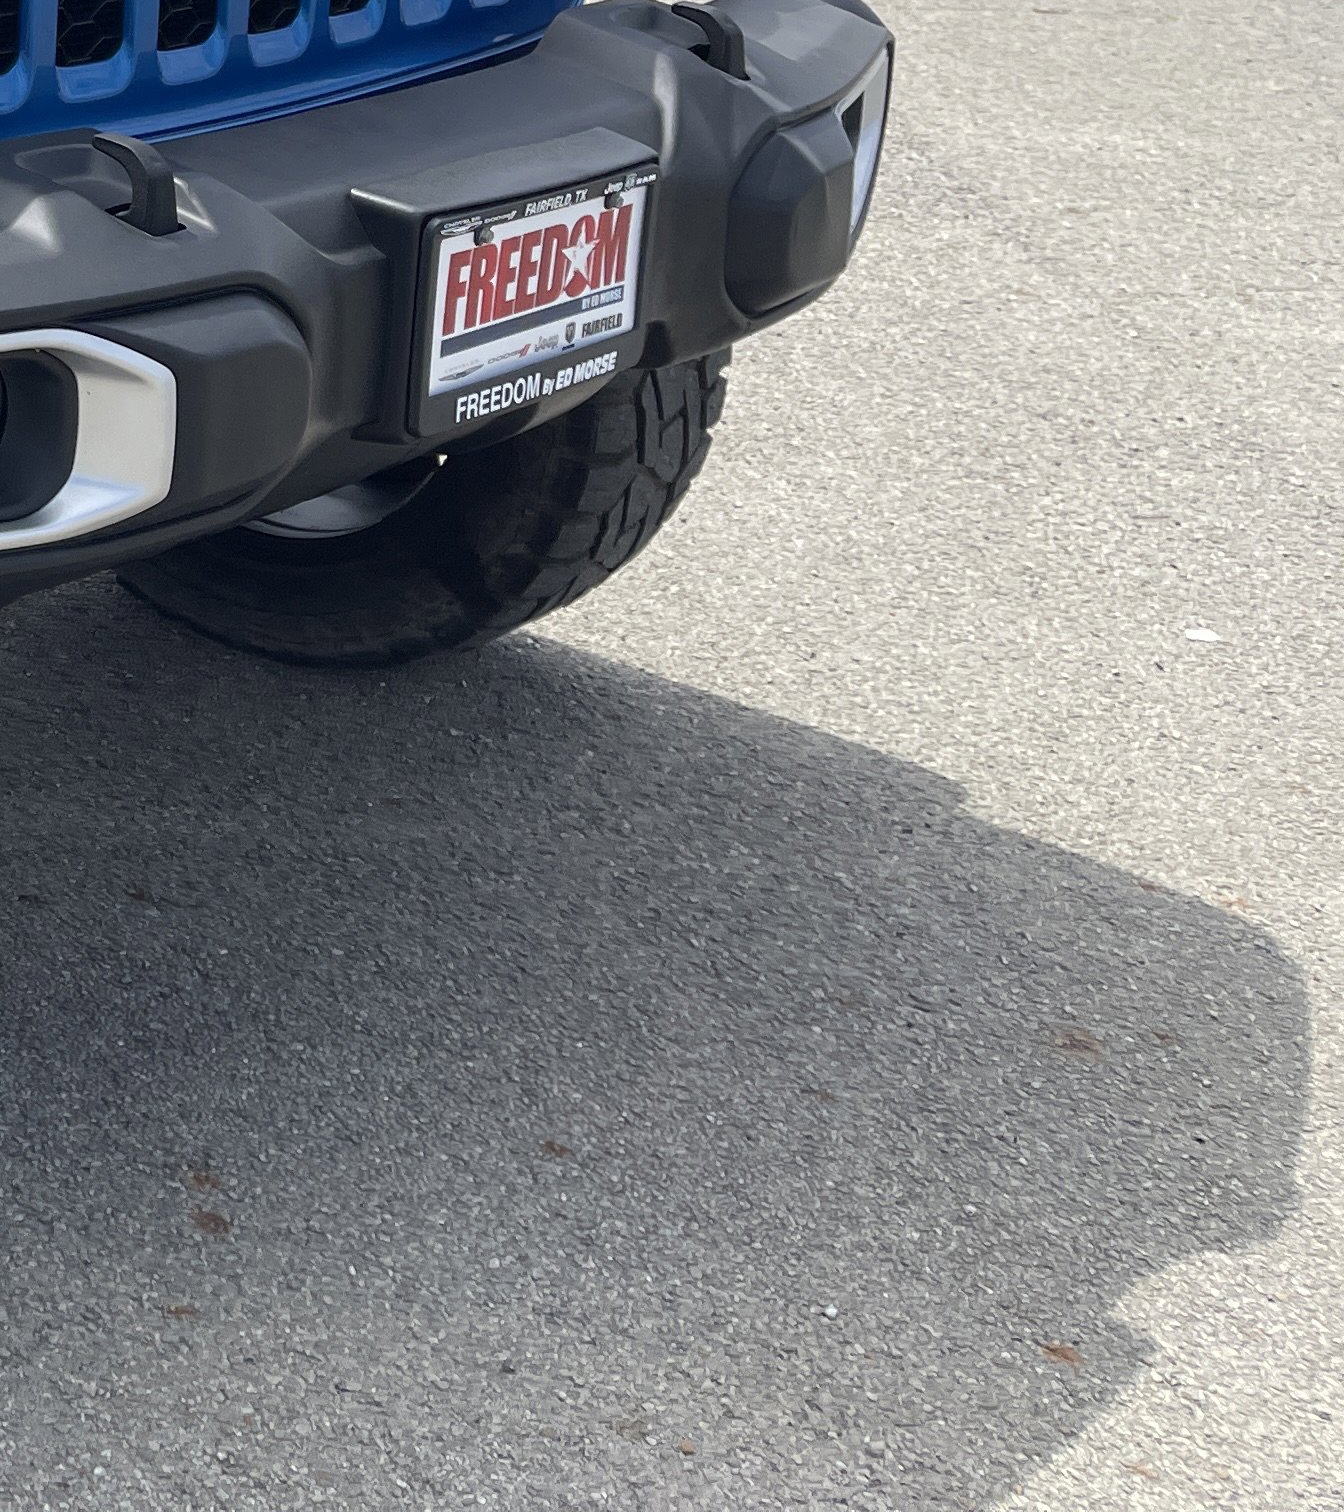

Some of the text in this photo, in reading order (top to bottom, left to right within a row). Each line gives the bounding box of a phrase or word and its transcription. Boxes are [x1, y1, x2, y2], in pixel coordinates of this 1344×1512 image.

[575, 188, 588, 202] TX
[442, 203, 634, 337] FREEDOM
[581, 312, 623, 339] FAIRFIELD
[534, 334, 559, 353] Jeep
[455, 372, 541, 424] FREEDOM
[555, 367, 574, 393] ED
[573, 351, 618, 385] MORSE
